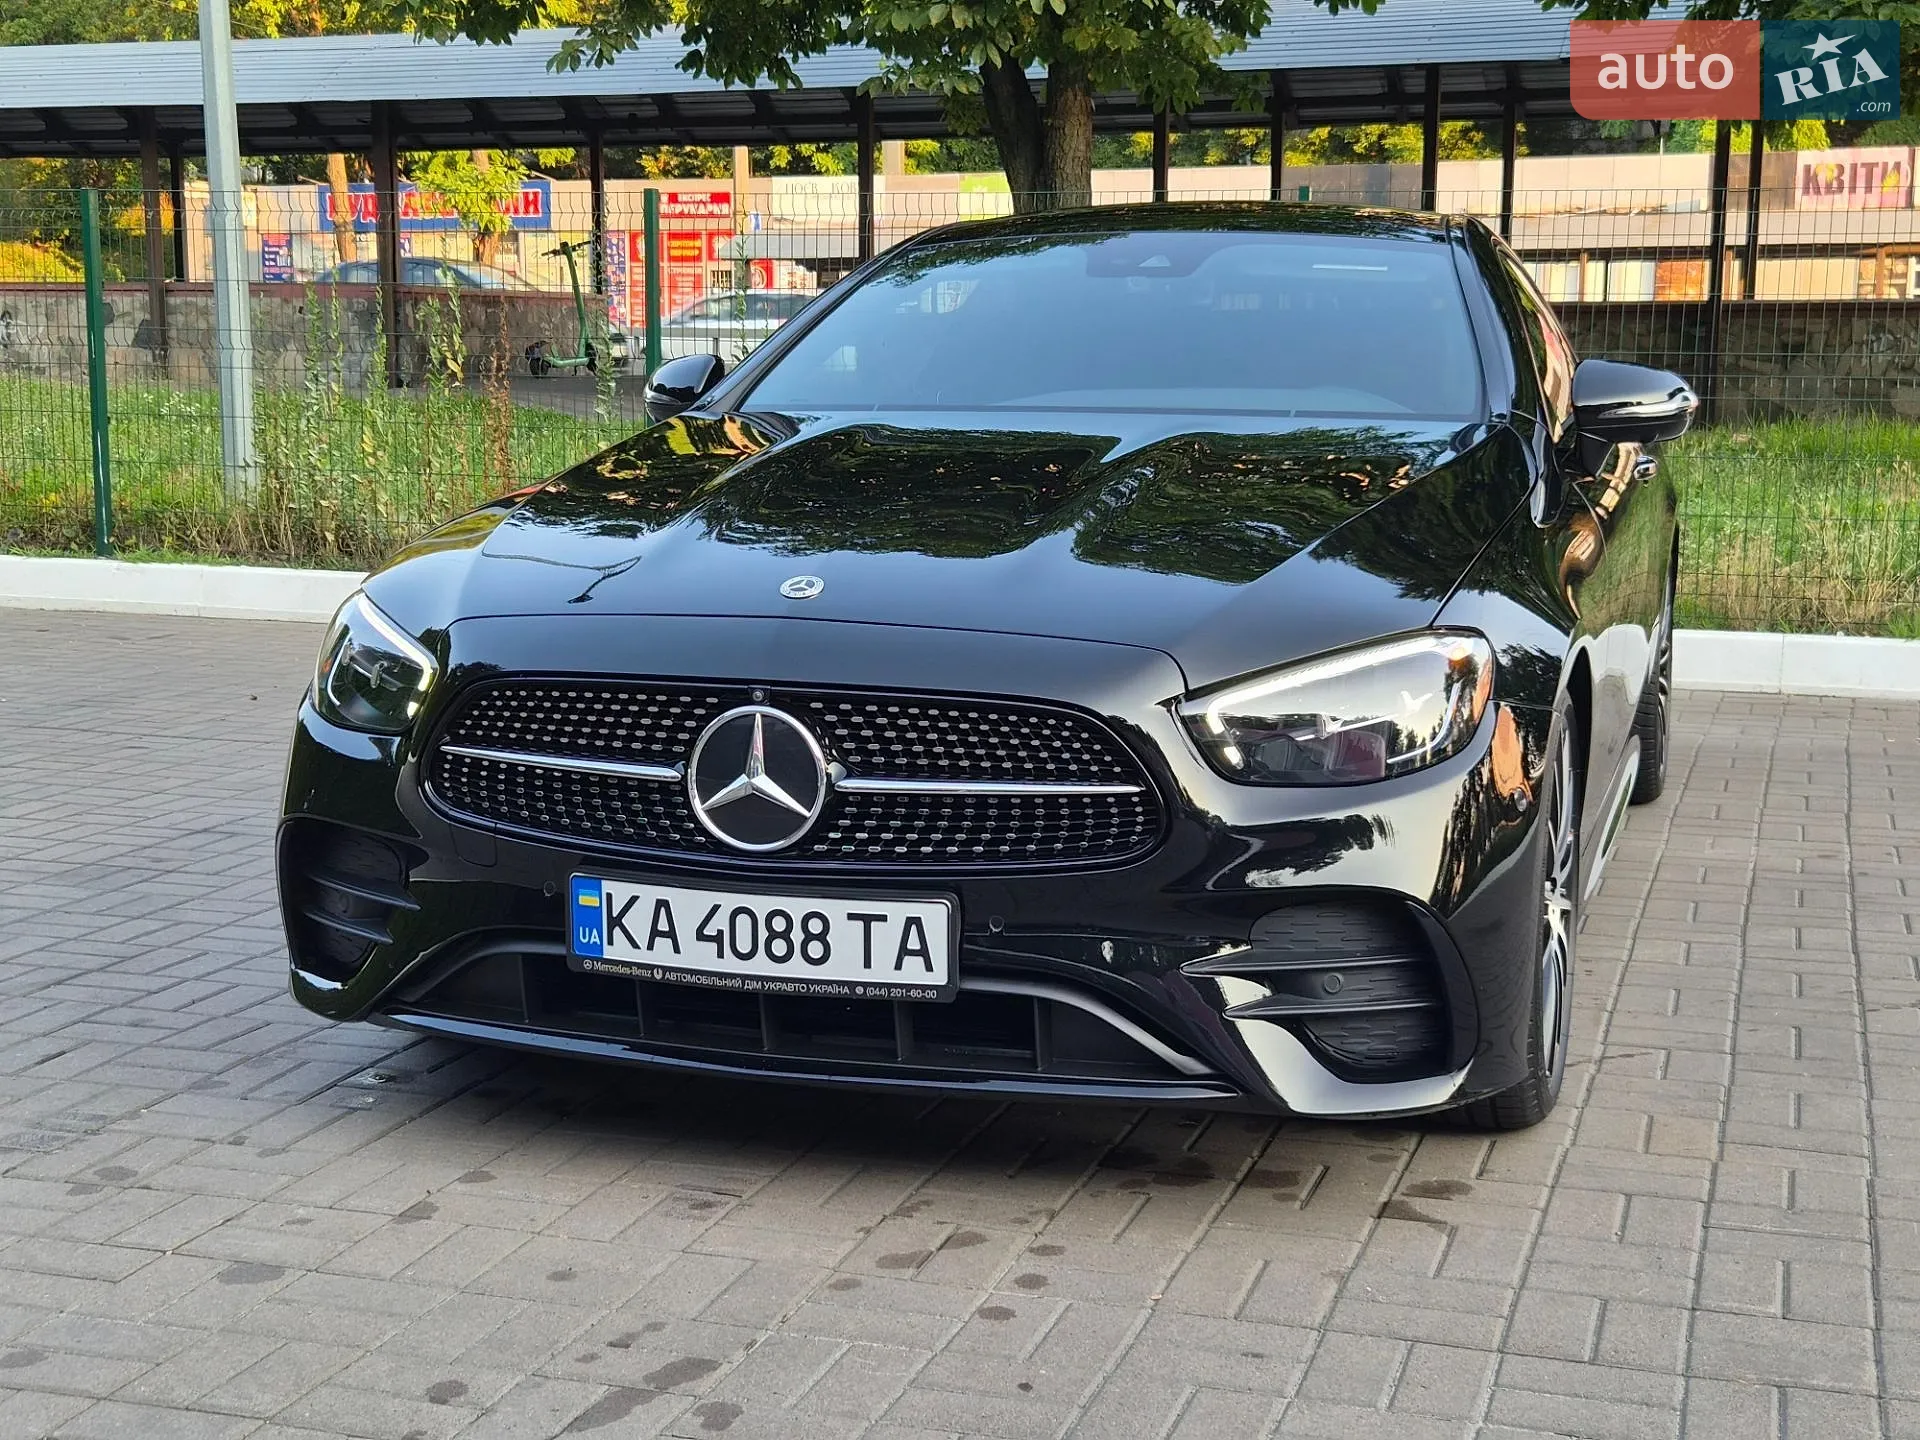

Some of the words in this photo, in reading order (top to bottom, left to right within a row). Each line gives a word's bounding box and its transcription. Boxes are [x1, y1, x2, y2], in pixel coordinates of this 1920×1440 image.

[1802, 160, 1901, 196] КВІТИ
[659, 203, 730, 215] ПЕРУКАРНЯ
[579, 926, 601, 945] UA
[605, 891, 681, 955] KA
[696, 903, 831, 966] 4088
[847, 912, 934, 973] TA
[593, 960, 652, 978] Mercedes-Benz
[664, 971, 742, 988] АВТОМОБІЛЬНИЙ
[744, 980, 761, 991] ДІМ
[763, 980, 807, 993] УКРАВТО
[809, 983, 850, 995] УКРАЇНА
[866, 986, 888, 998] (044)
[890, 988, 937, 999] 201-60-00
